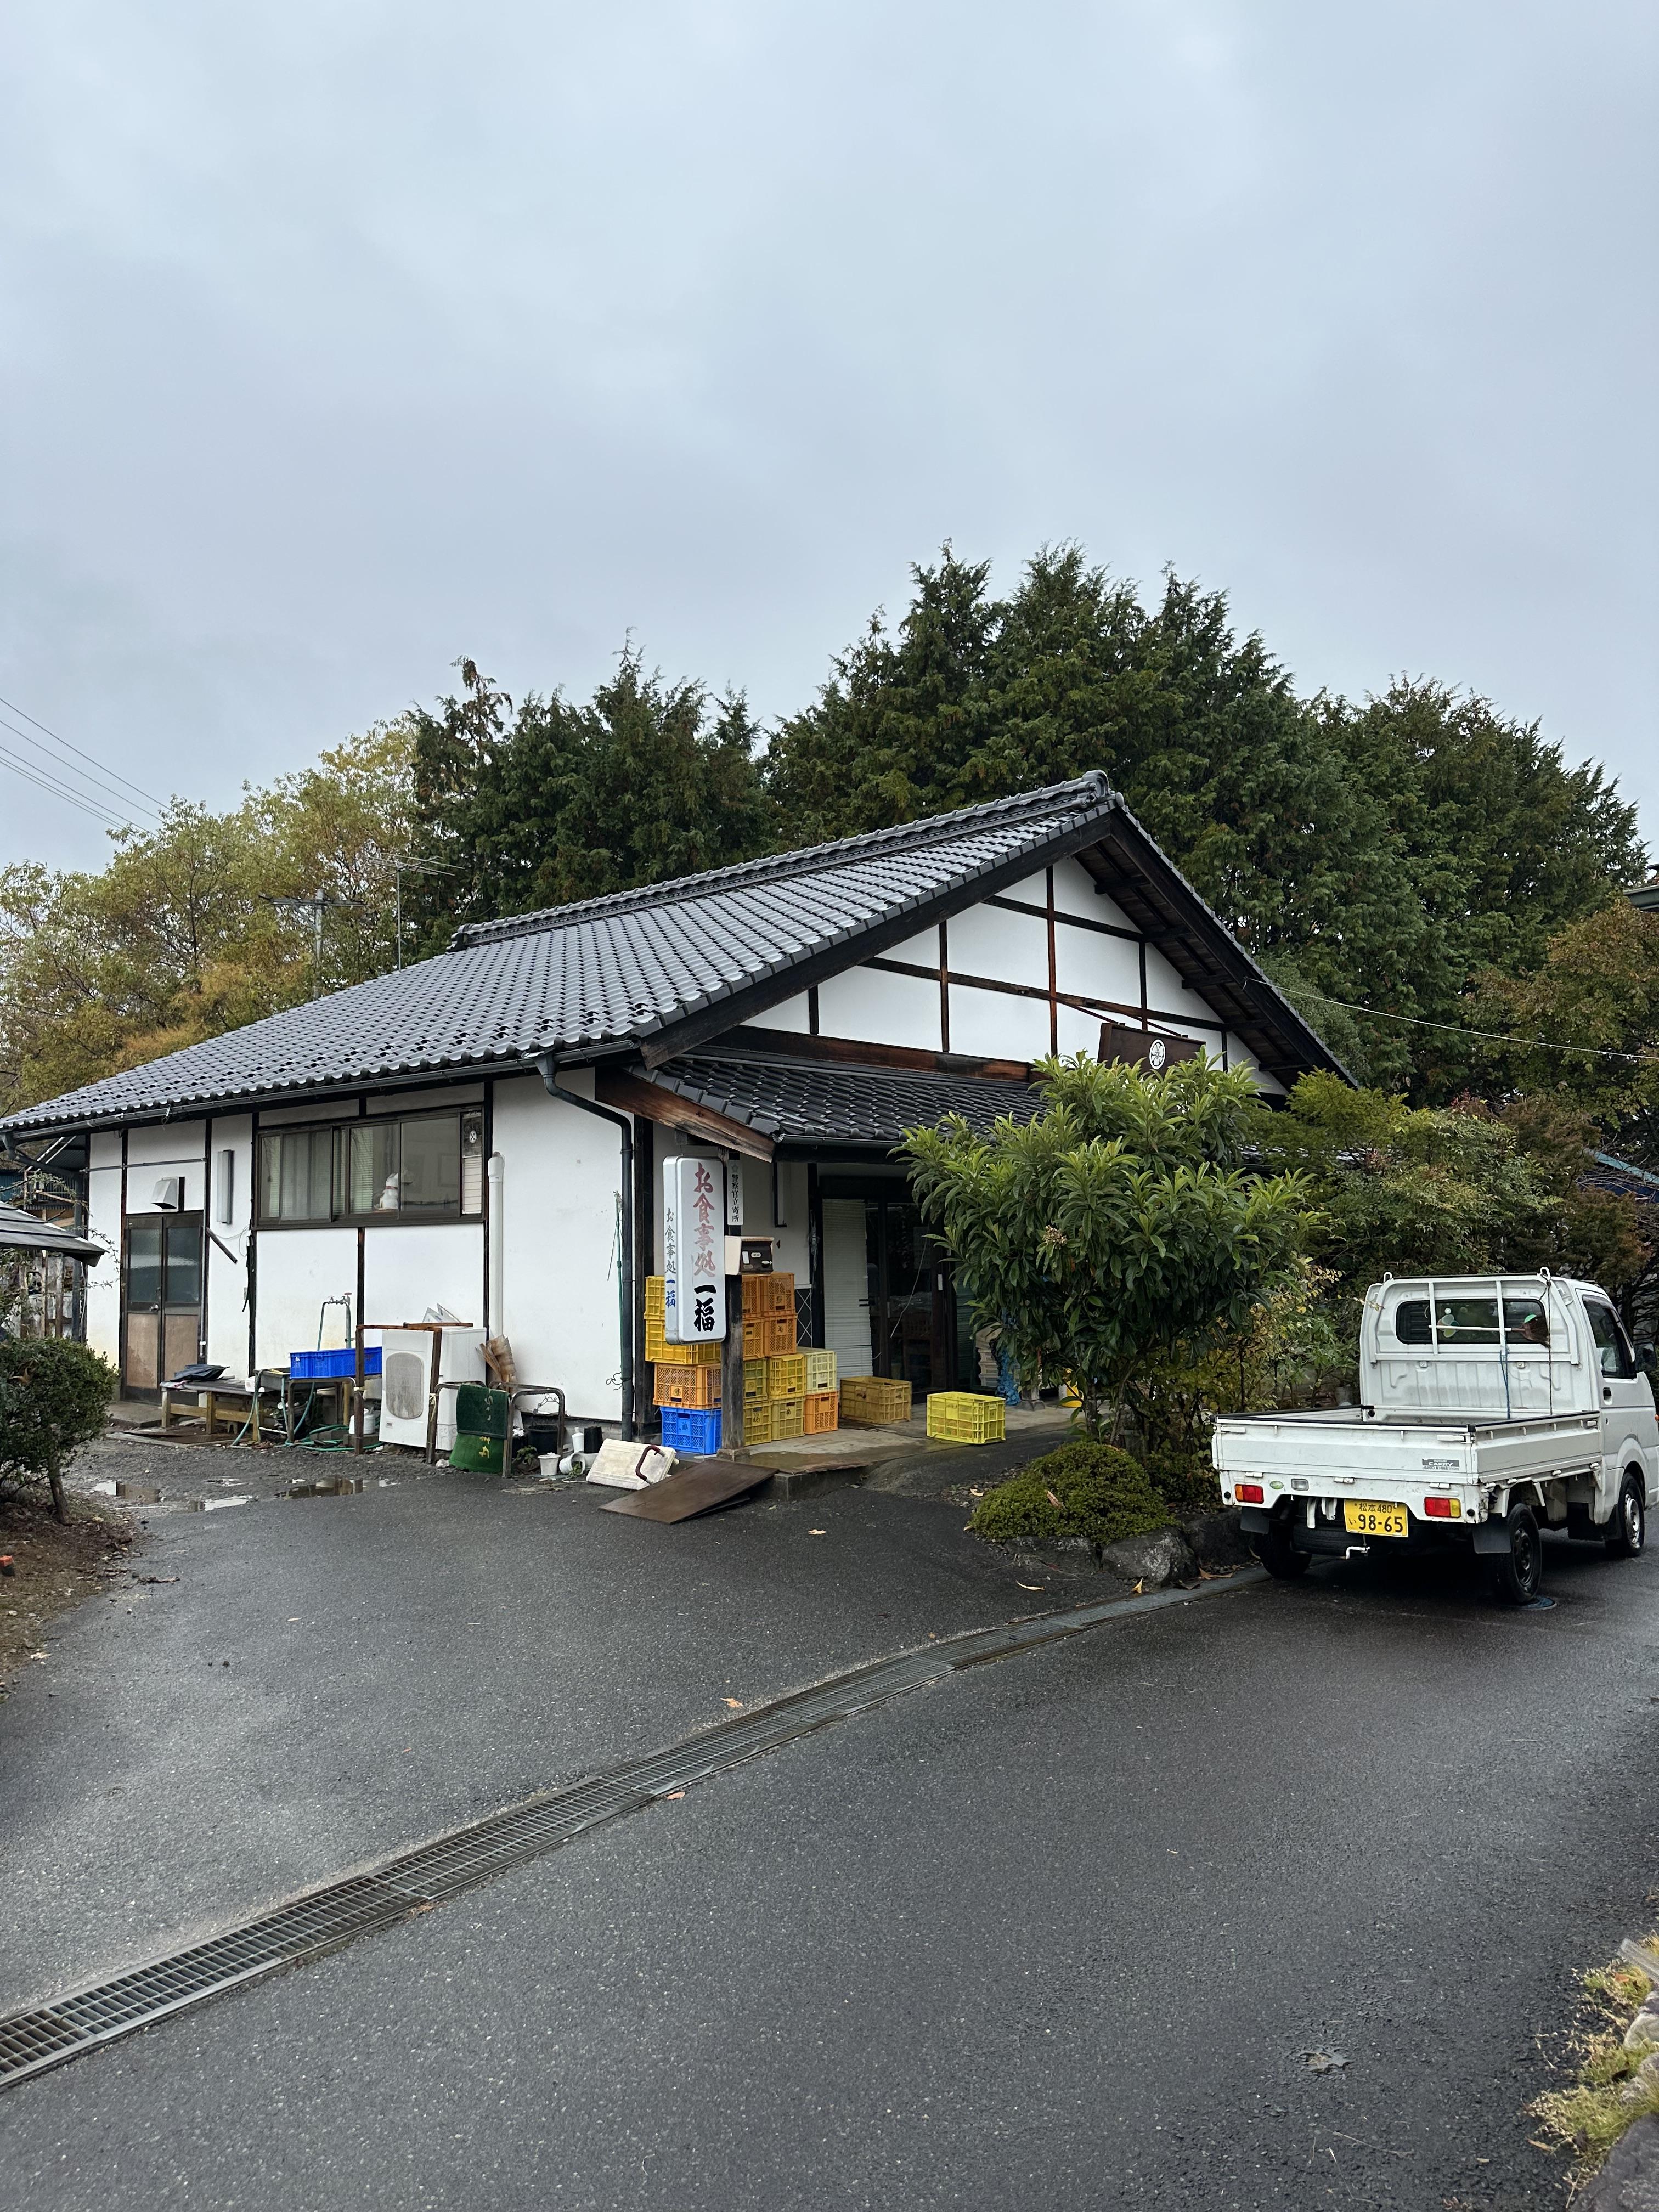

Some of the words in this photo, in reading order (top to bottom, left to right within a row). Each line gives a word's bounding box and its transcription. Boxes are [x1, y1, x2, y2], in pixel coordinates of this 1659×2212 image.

[693, 1161, 715, 1278] お食事処
[664, 1207, 676, 1274] お食事処
[665, 1279, 676, 1308] 一福
[693, 1284, 716, 1333] 一福
[1358, 1514, 1403, 1533] 98-65
[1359, 1503, 1376, 1512] 松本
[1377, 1504, 1392, 1514] 480
